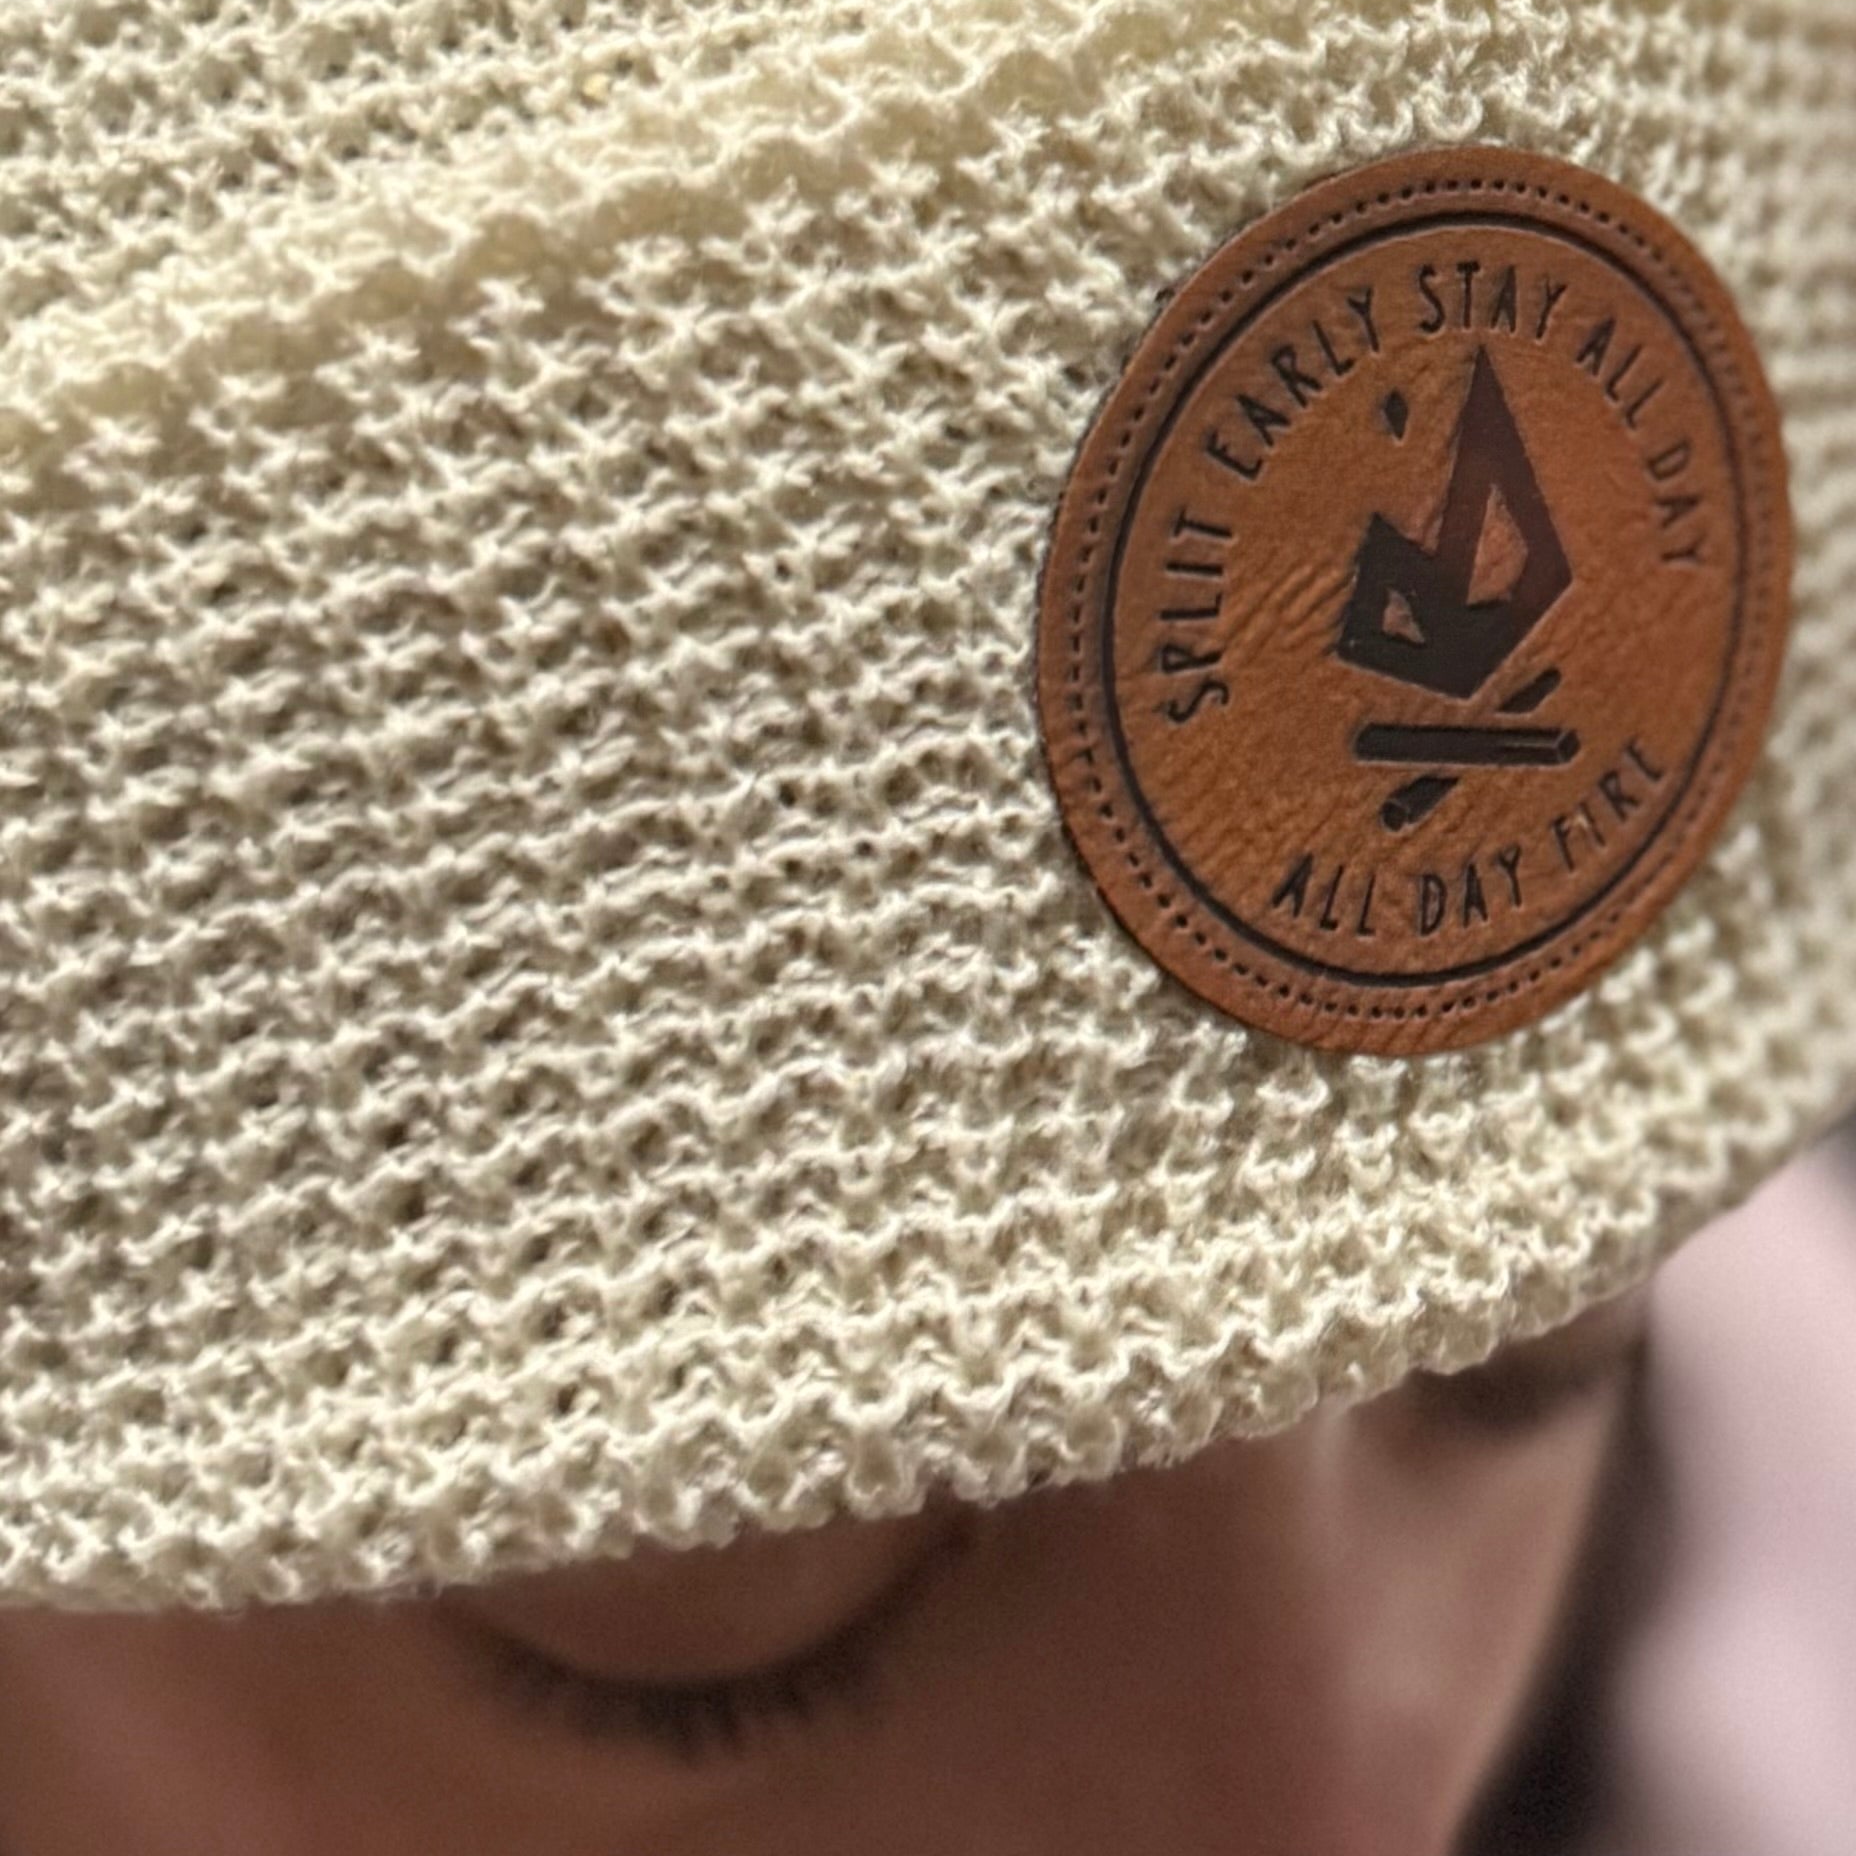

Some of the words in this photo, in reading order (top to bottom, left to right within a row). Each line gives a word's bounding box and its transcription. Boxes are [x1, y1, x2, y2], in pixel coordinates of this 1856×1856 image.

[1160, 508, 1233, 723] SPLIT
[1206, 286, 1381, 481] EARLY
[1418, 261, 1568, 340] STAY
[1575, 317, 1663, 430] ALL
[1647, 442, 1704, 566] DAY
[1271, 853, 1376, 936] ALL
[1420, 847, 1526, 936] DAY
[1551, 736, 1668, 871] FIRE
